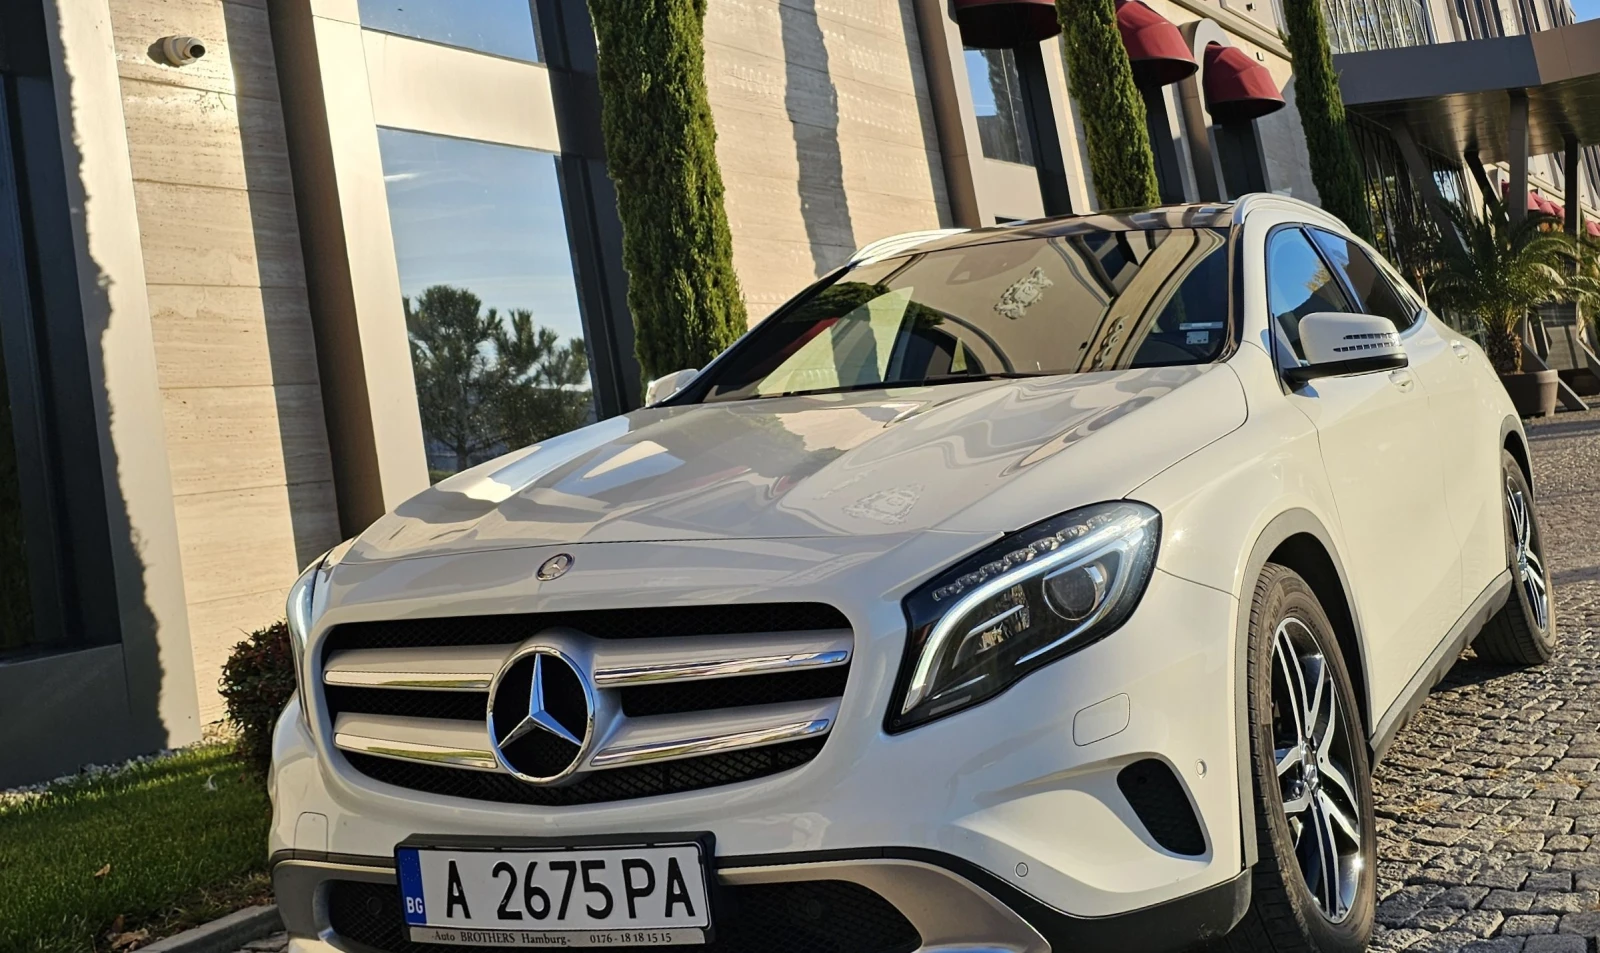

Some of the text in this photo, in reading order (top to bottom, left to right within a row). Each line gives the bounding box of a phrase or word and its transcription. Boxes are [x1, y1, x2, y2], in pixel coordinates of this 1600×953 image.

[446, 860, 472, 919] A
[406, 896, 424, 914] BG
[460, 931, 516, 943] BROTHERS
[633, 933, 645, 943] 18
[647, 933, 659, 943] 15
[661, 932, 672, 943] 15
